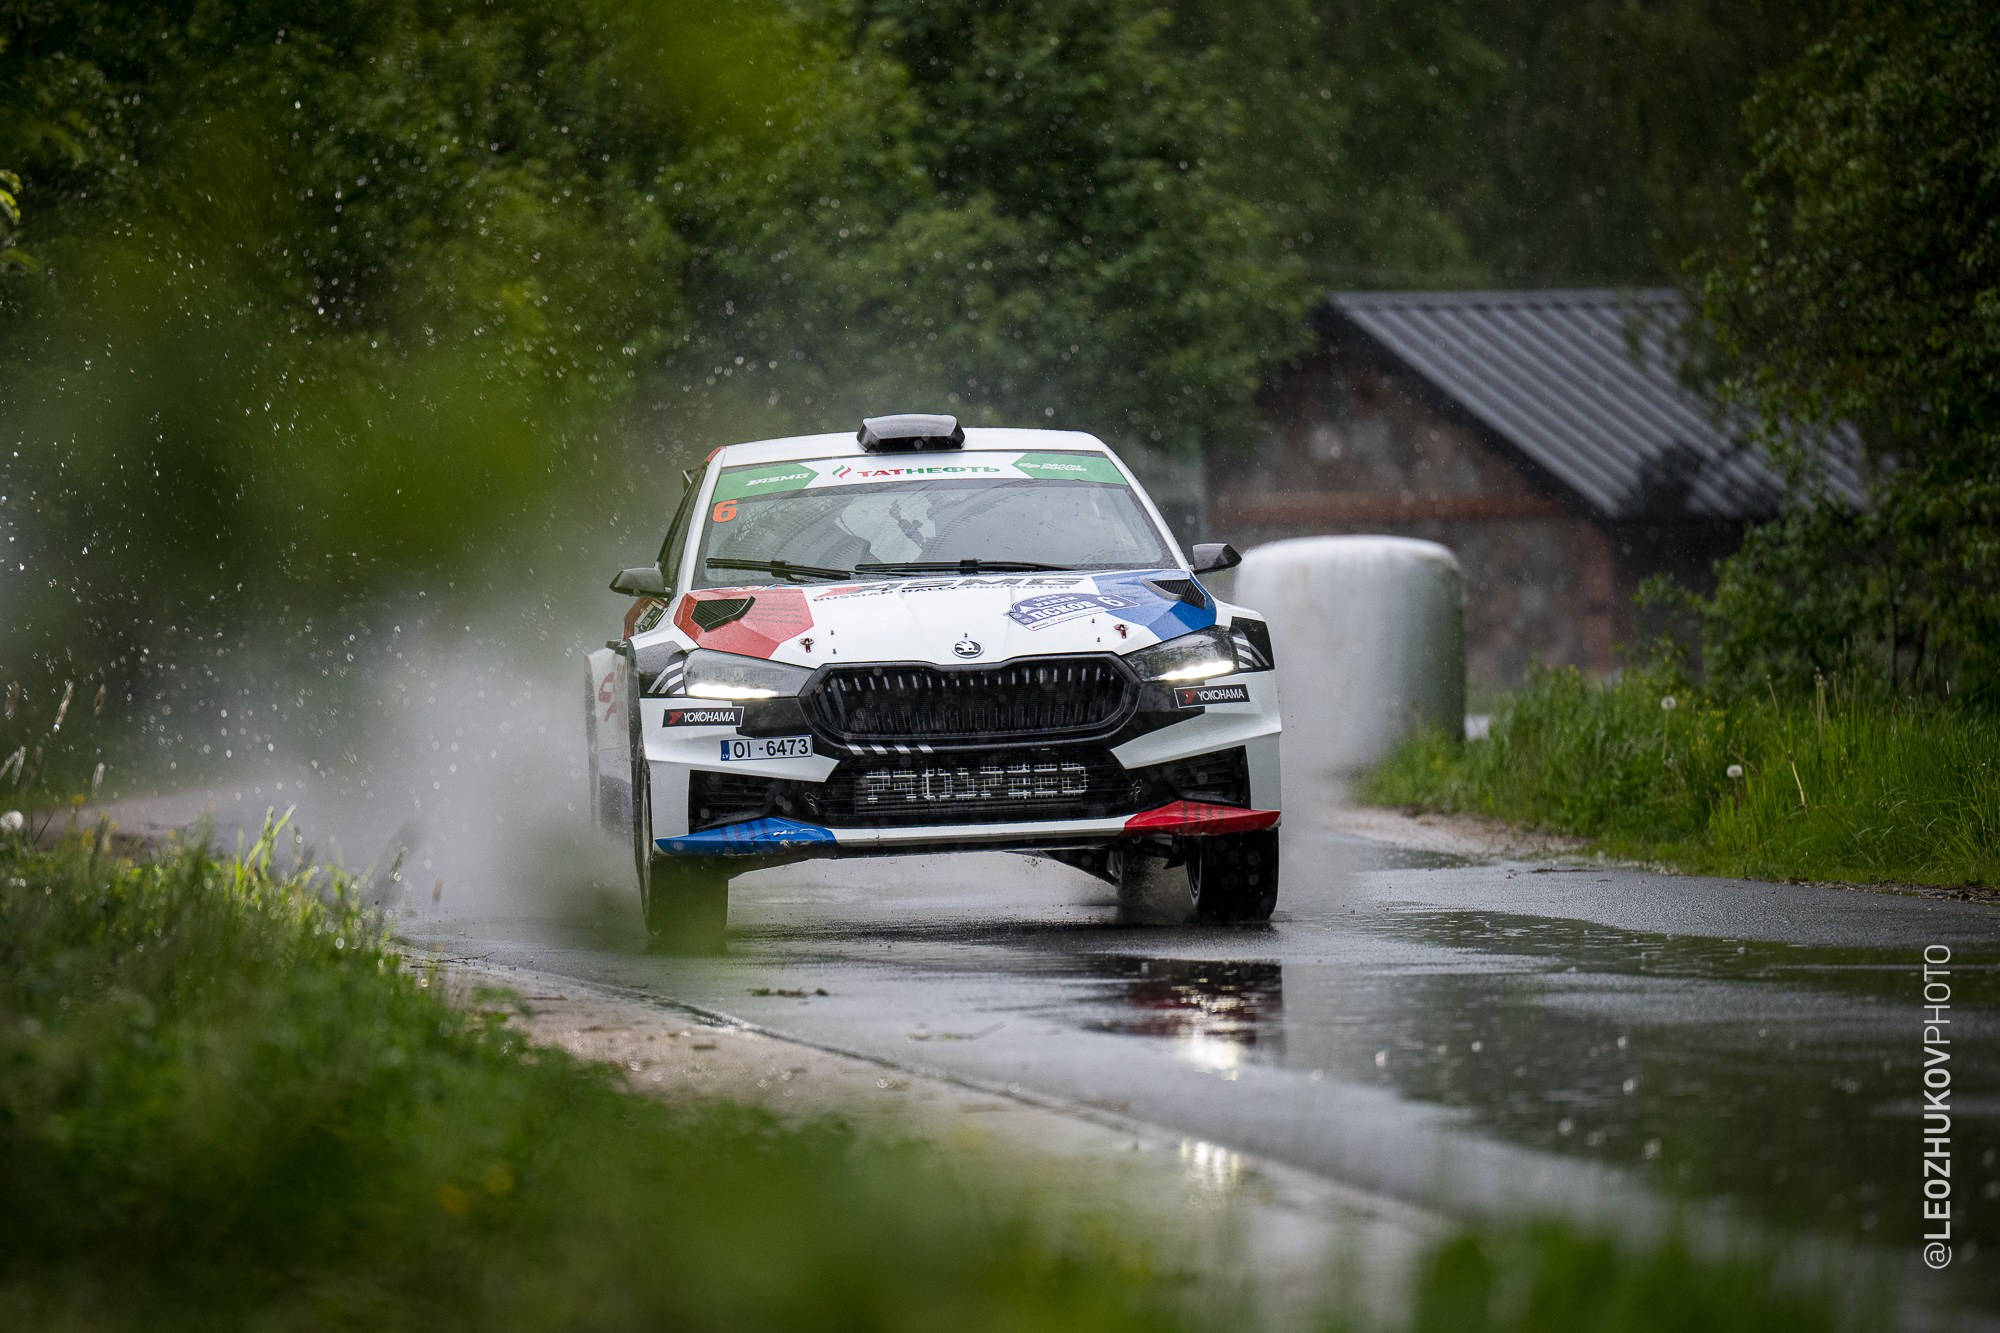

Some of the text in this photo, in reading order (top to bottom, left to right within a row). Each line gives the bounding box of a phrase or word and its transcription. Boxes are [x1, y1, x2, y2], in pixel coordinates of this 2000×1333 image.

[857, 466, 1001, 478] ТАТНЕФТЬ
[712, 499, 738, 523] 6
[1097, 596, 1125, 607] 6
[1028, 600, 1097, 619] ПСКОВ
[1197, 688, 1245, 701] YOKOHAMA
[683, 711, 736, 723] YOKOHAMA
